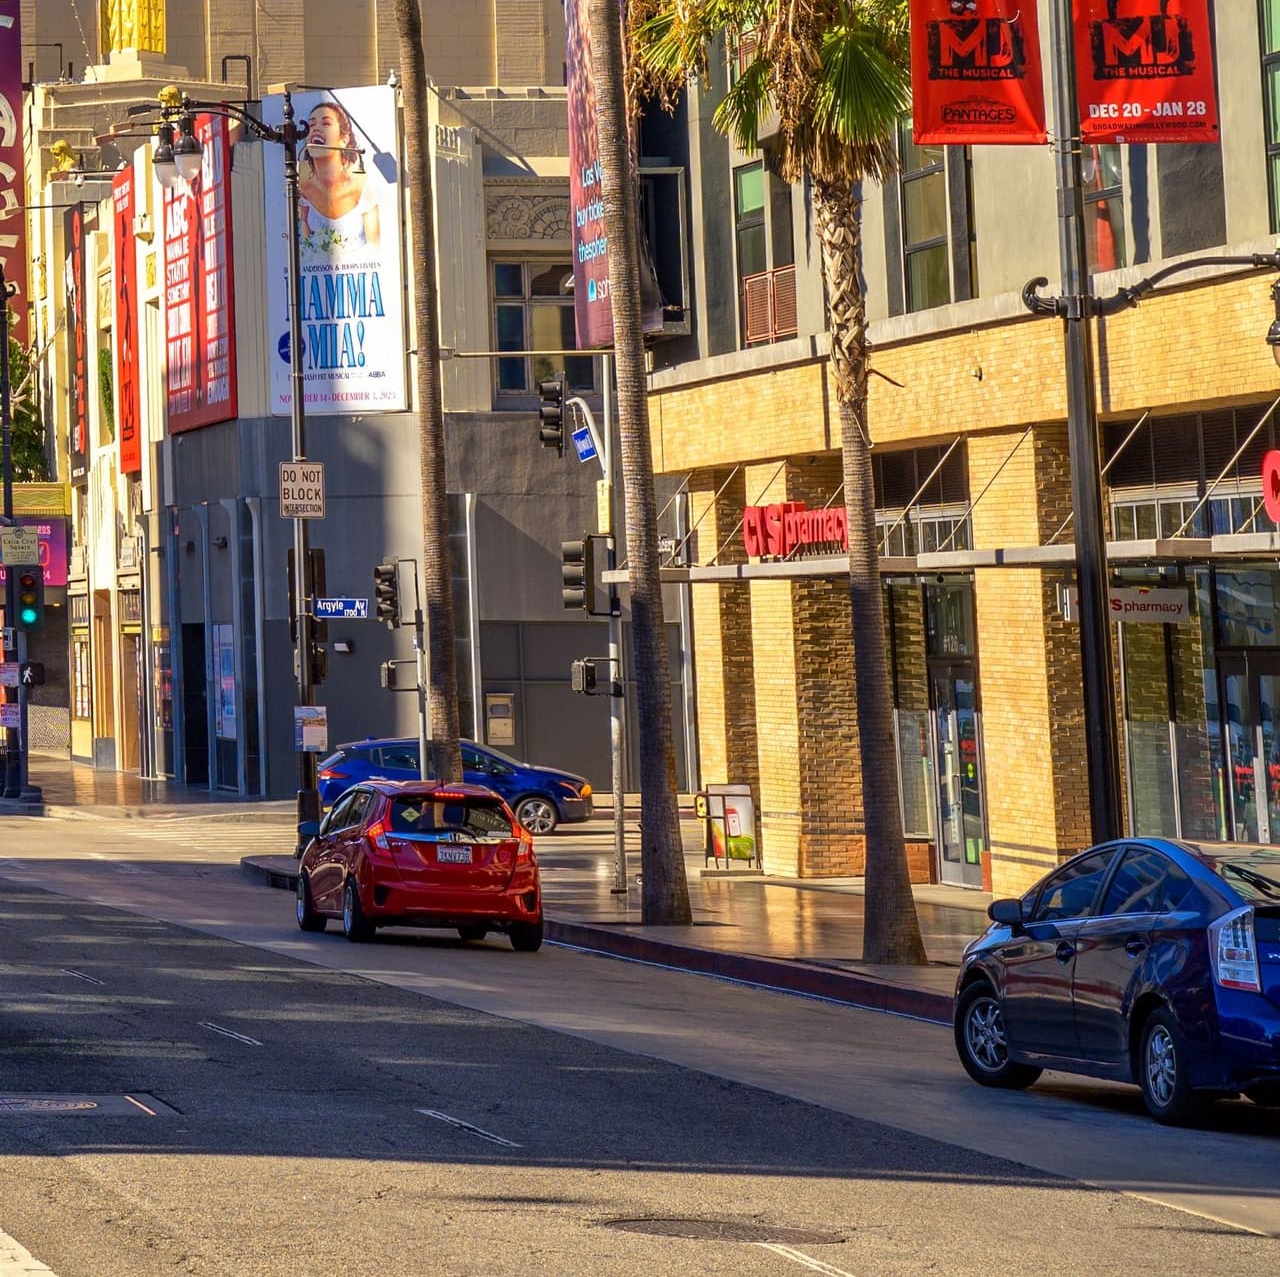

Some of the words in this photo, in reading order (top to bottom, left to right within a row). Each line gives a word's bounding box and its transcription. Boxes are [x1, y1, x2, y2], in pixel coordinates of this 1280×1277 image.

[938, 22, 1014, 66] MJ
[1103, 19, 1180, 66] MJ
[939, 69, 958, 77] THE
[962, 68, 1014, 78] MUSICAL
[1104, 68, 1126, 76] THE
[1129, 66, 1180, 76] MUSICAL
[943, 108, 1015, 122] PANTAGES
[1089, 104, 1118, 118] DEC
[1122, 103, 1142, 117] 20
[1152, 102, 1182, 116] JAN
[1186, 101, 1206, 115] 28
[166, 194, 188, 242] ABC
[576, 205, 588, 228] buy
[308, 320, 366, 370] MIA!
[283, 470, 297, 483] DO
[302, 470, 321, 483] NOT
[283, 488, 322, 500] BLOCK
[284, 503, 322, 513] INTERSECTION
[317, 600, 344, 613] Argyle
[355, 600, 365, 610] Av
[1124, 600, 1183, 613] pharmacy
